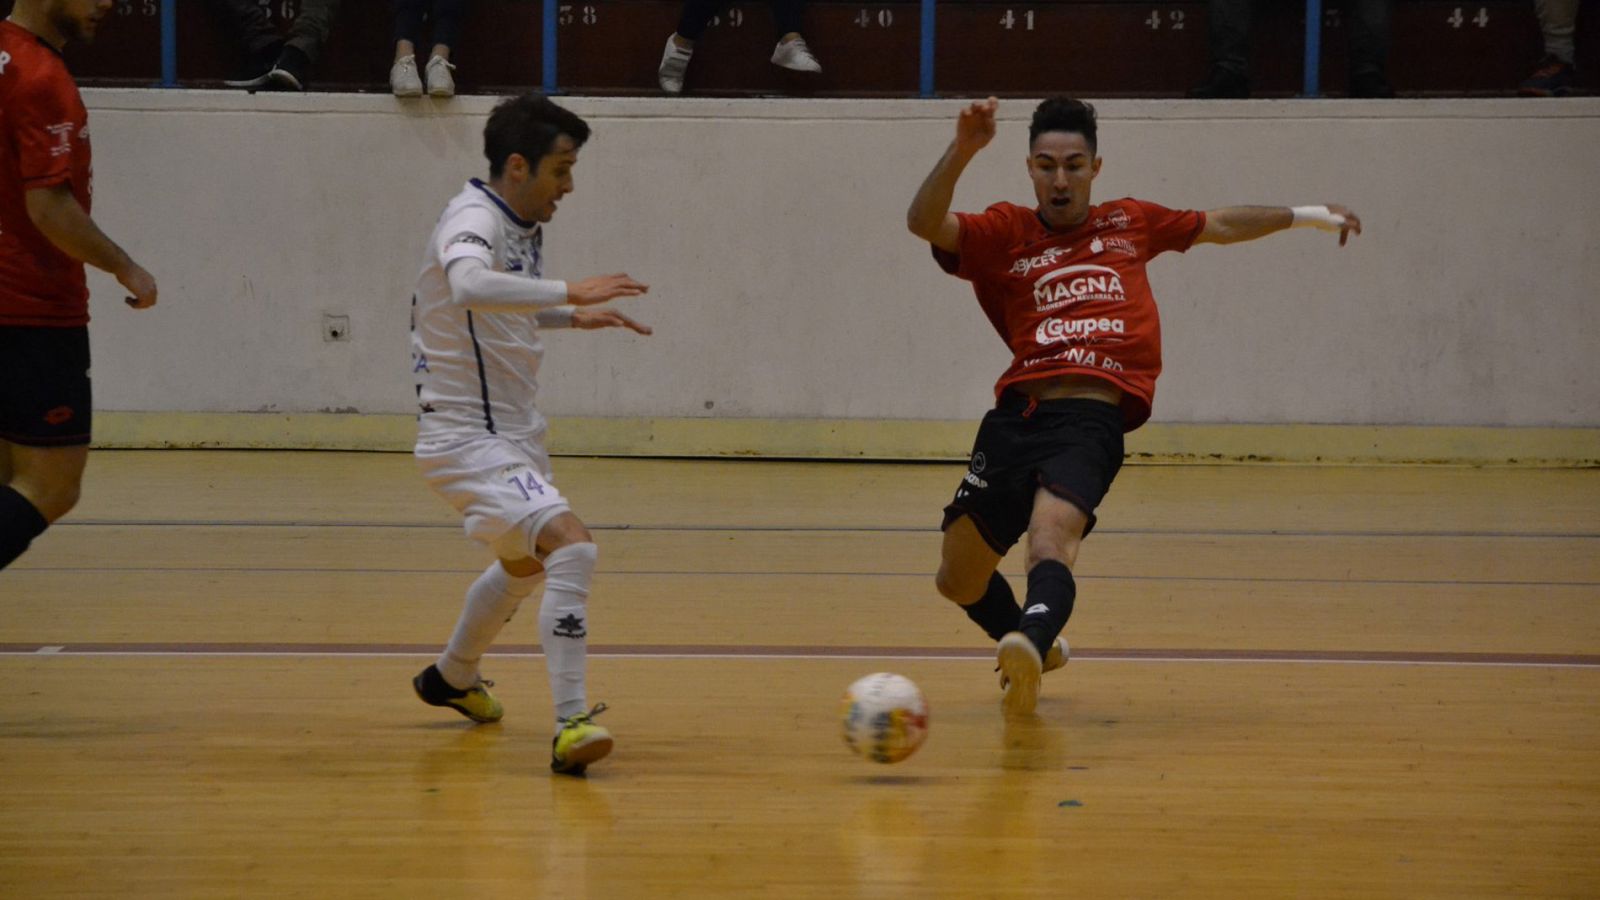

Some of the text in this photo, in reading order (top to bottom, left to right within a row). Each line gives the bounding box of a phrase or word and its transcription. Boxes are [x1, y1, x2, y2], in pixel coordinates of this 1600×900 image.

[559, 5, 597, 25] 38
[854, 9, 893, 28] 40
[999, 9, 1034, 30] 41
[1145, 10, 1184, 30] 42
[1446, 8, 1489, 28] 44
[1033, 276, 1124, 306] MAGNA
[1047, 318, 1124, 335] Gurpea
[507, 471, 544, 501] 14
